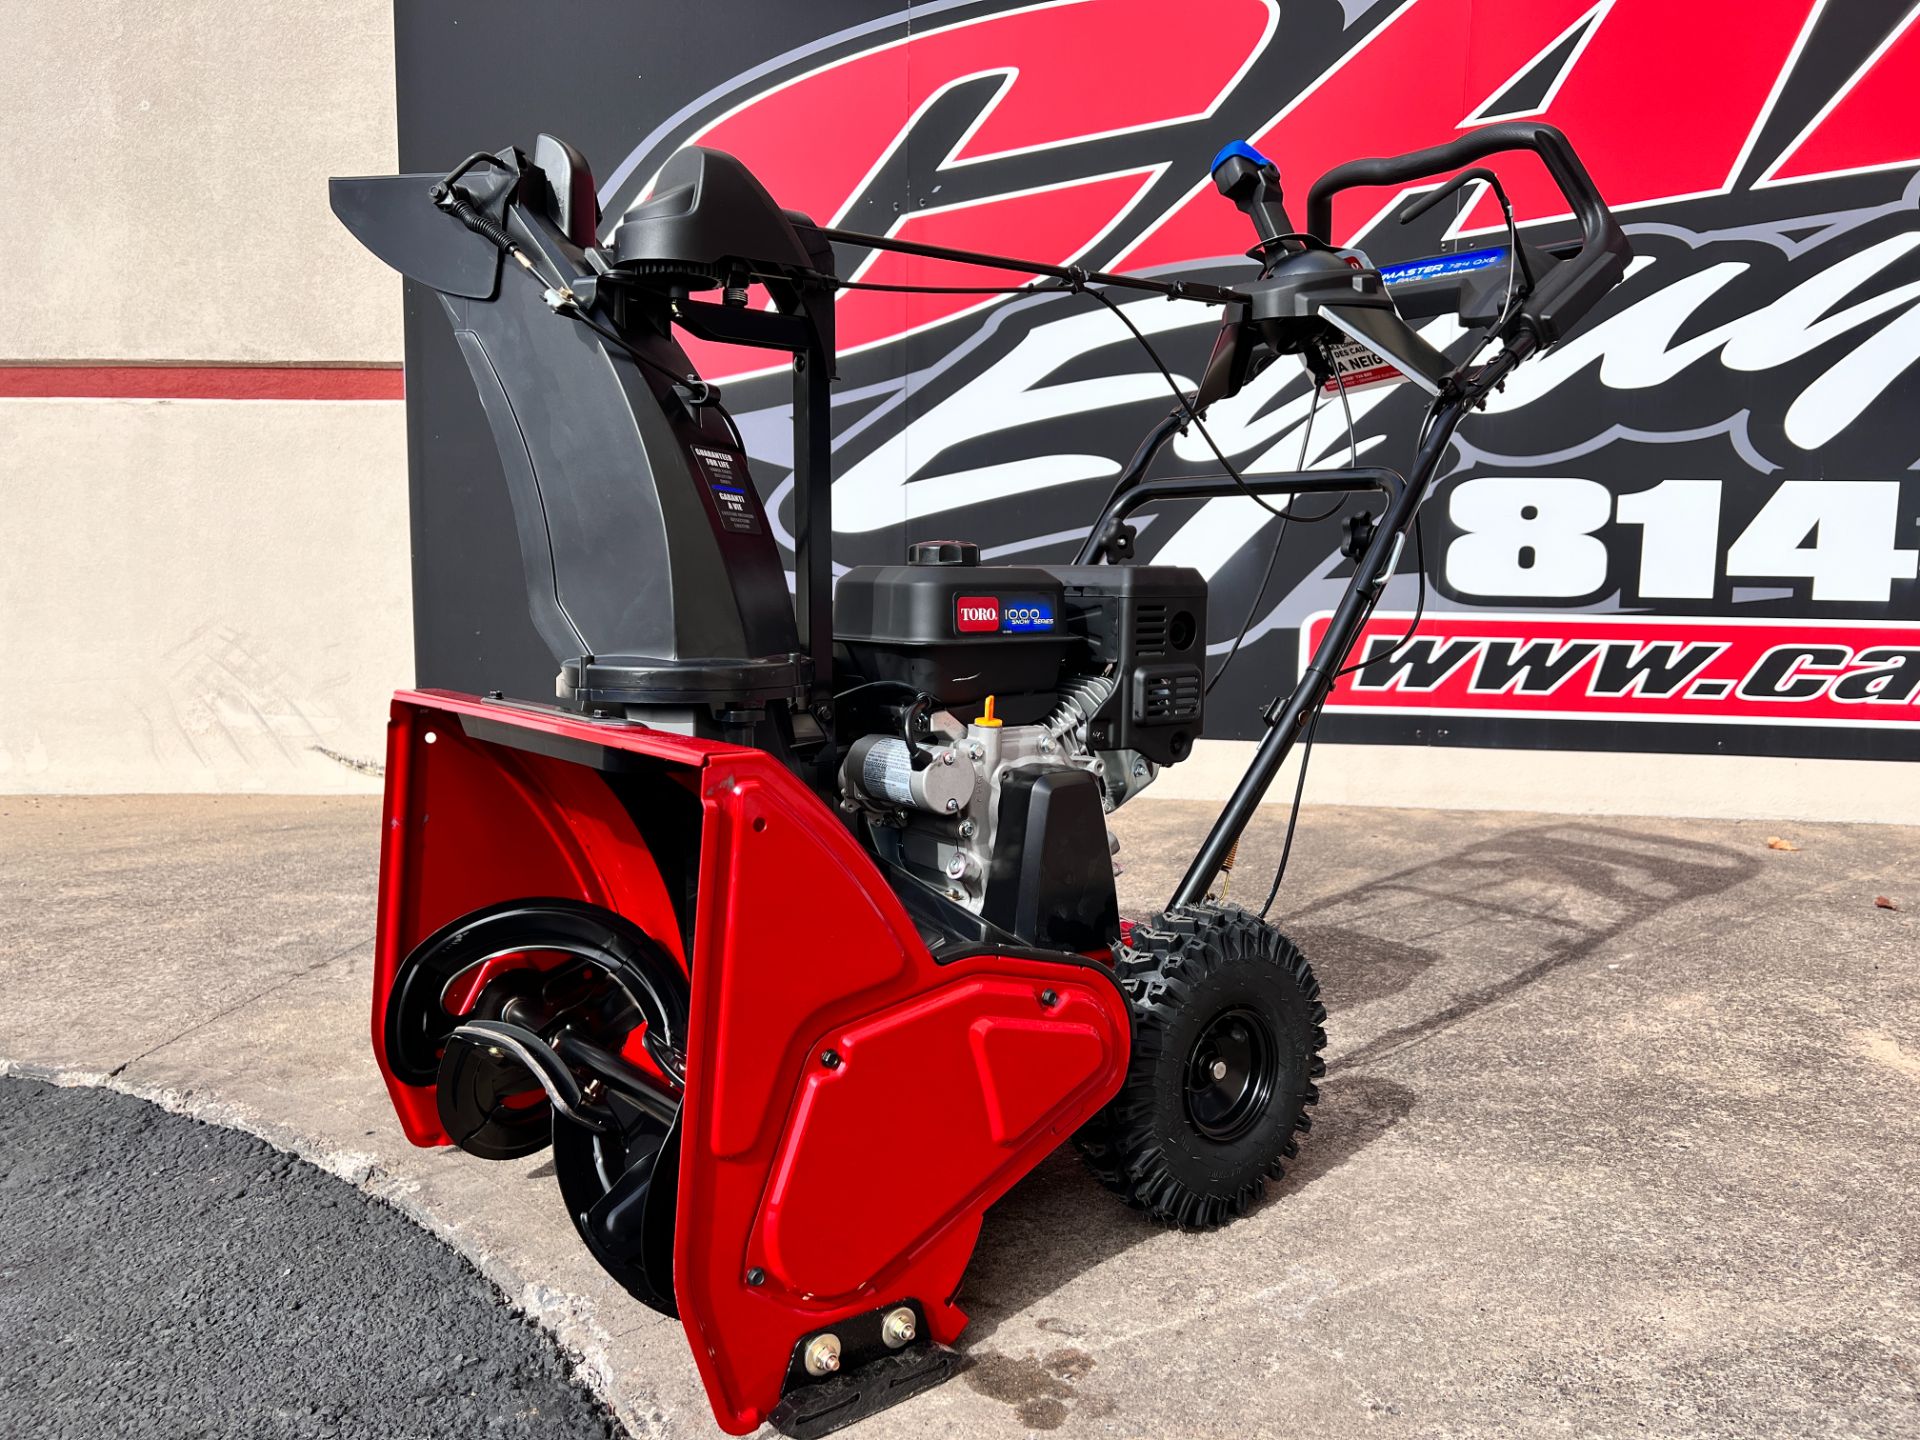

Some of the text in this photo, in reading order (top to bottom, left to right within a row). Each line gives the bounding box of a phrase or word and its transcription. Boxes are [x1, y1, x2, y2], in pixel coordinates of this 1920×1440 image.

[1473, 256, 1498, 265] QXE
[1334, 349, 1349, 358] DES
[1349, 353, 1384, 371] NEIG
[695, 448, 733, 462] GUARANTEED
[706, 458, 730, 469] FOR LIFE
[960, 607, 1039, 621] TORO 1000
